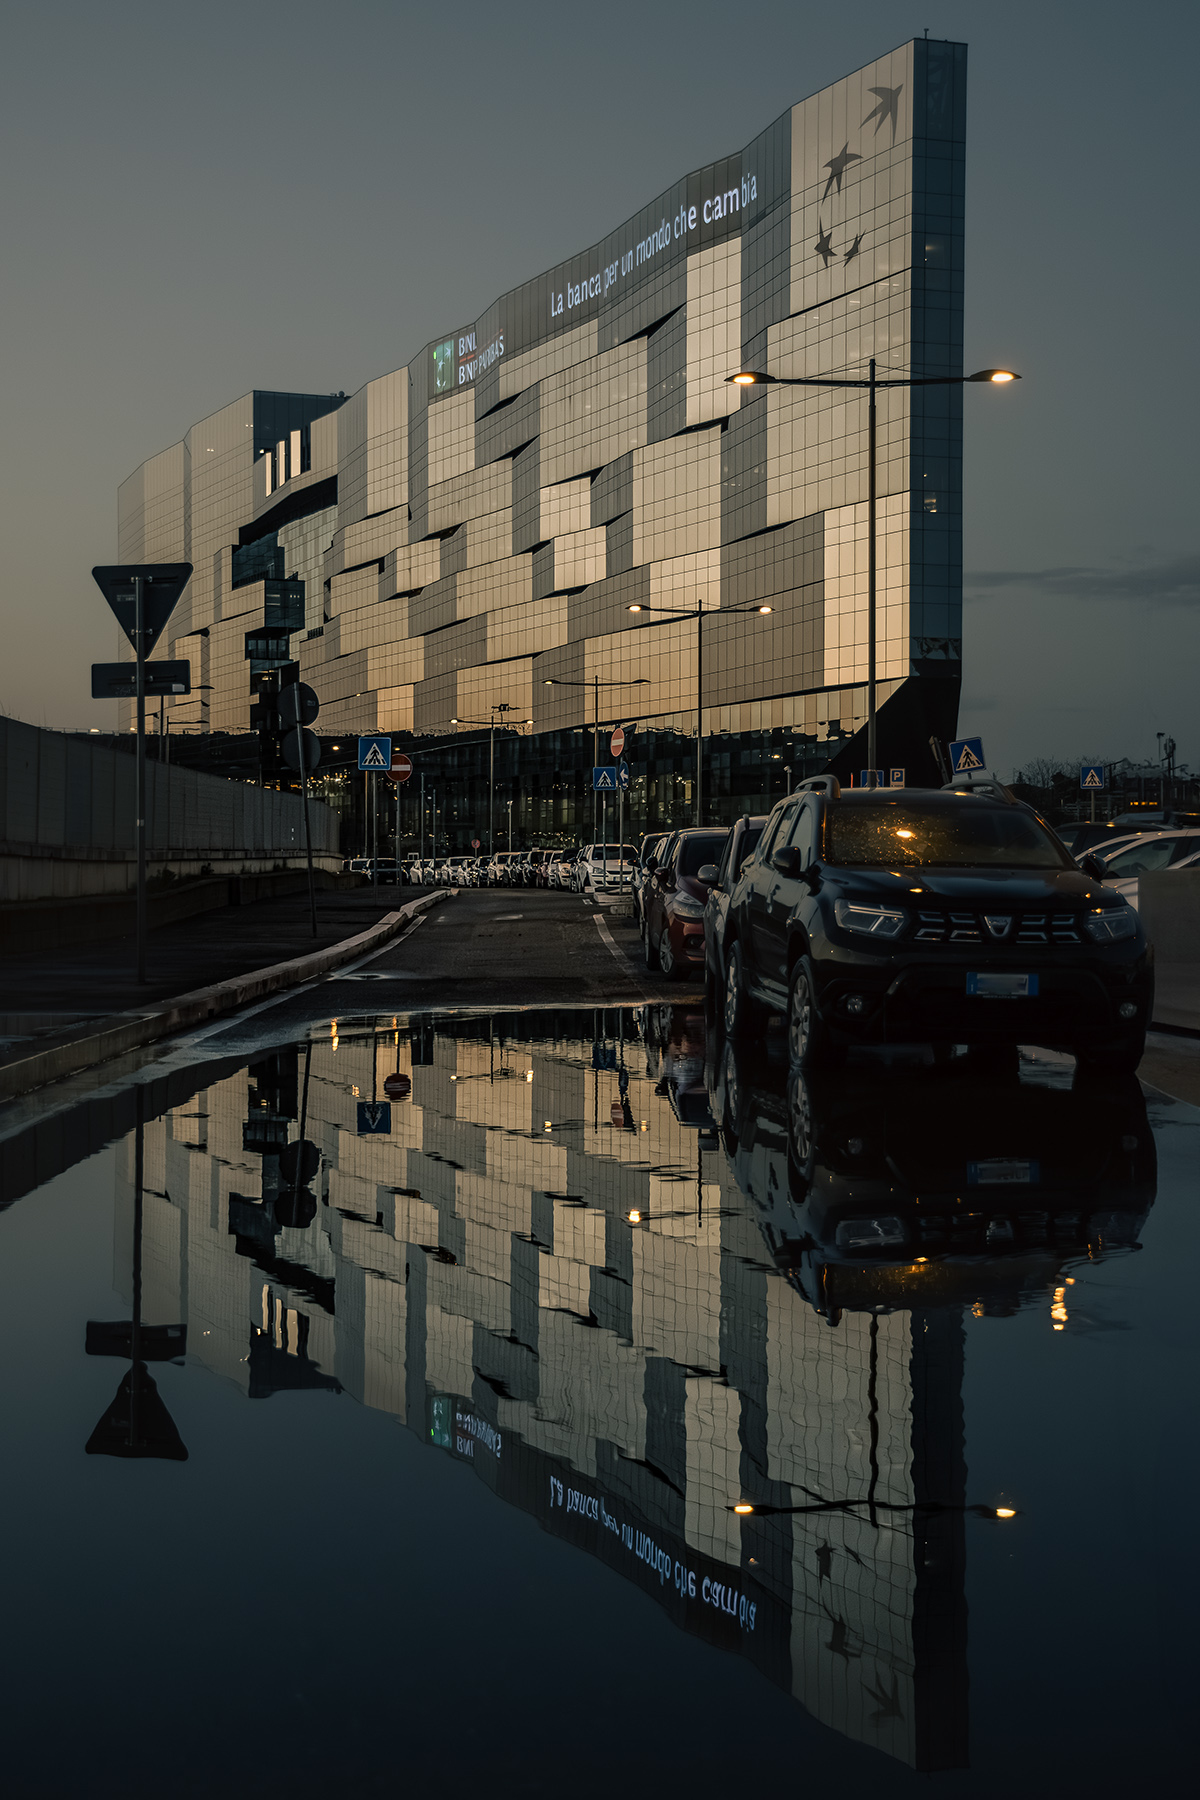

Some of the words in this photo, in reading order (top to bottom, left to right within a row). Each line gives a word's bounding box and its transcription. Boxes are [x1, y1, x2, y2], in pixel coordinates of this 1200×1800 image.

[551, 292, 564, 317] La
[567, 273, 601, 309] banca
[603, 260, 619, 298] per
[621, 250, 633, 277] un
[636, 218, 671, 266] mondo
[674, 205, 697, 239] che
[703, 172, 757, 224] cambia
[458, 332, 477, 357] BNL
[458, 360, 478, 385] BNP
[893, 771, 902, 781] P
